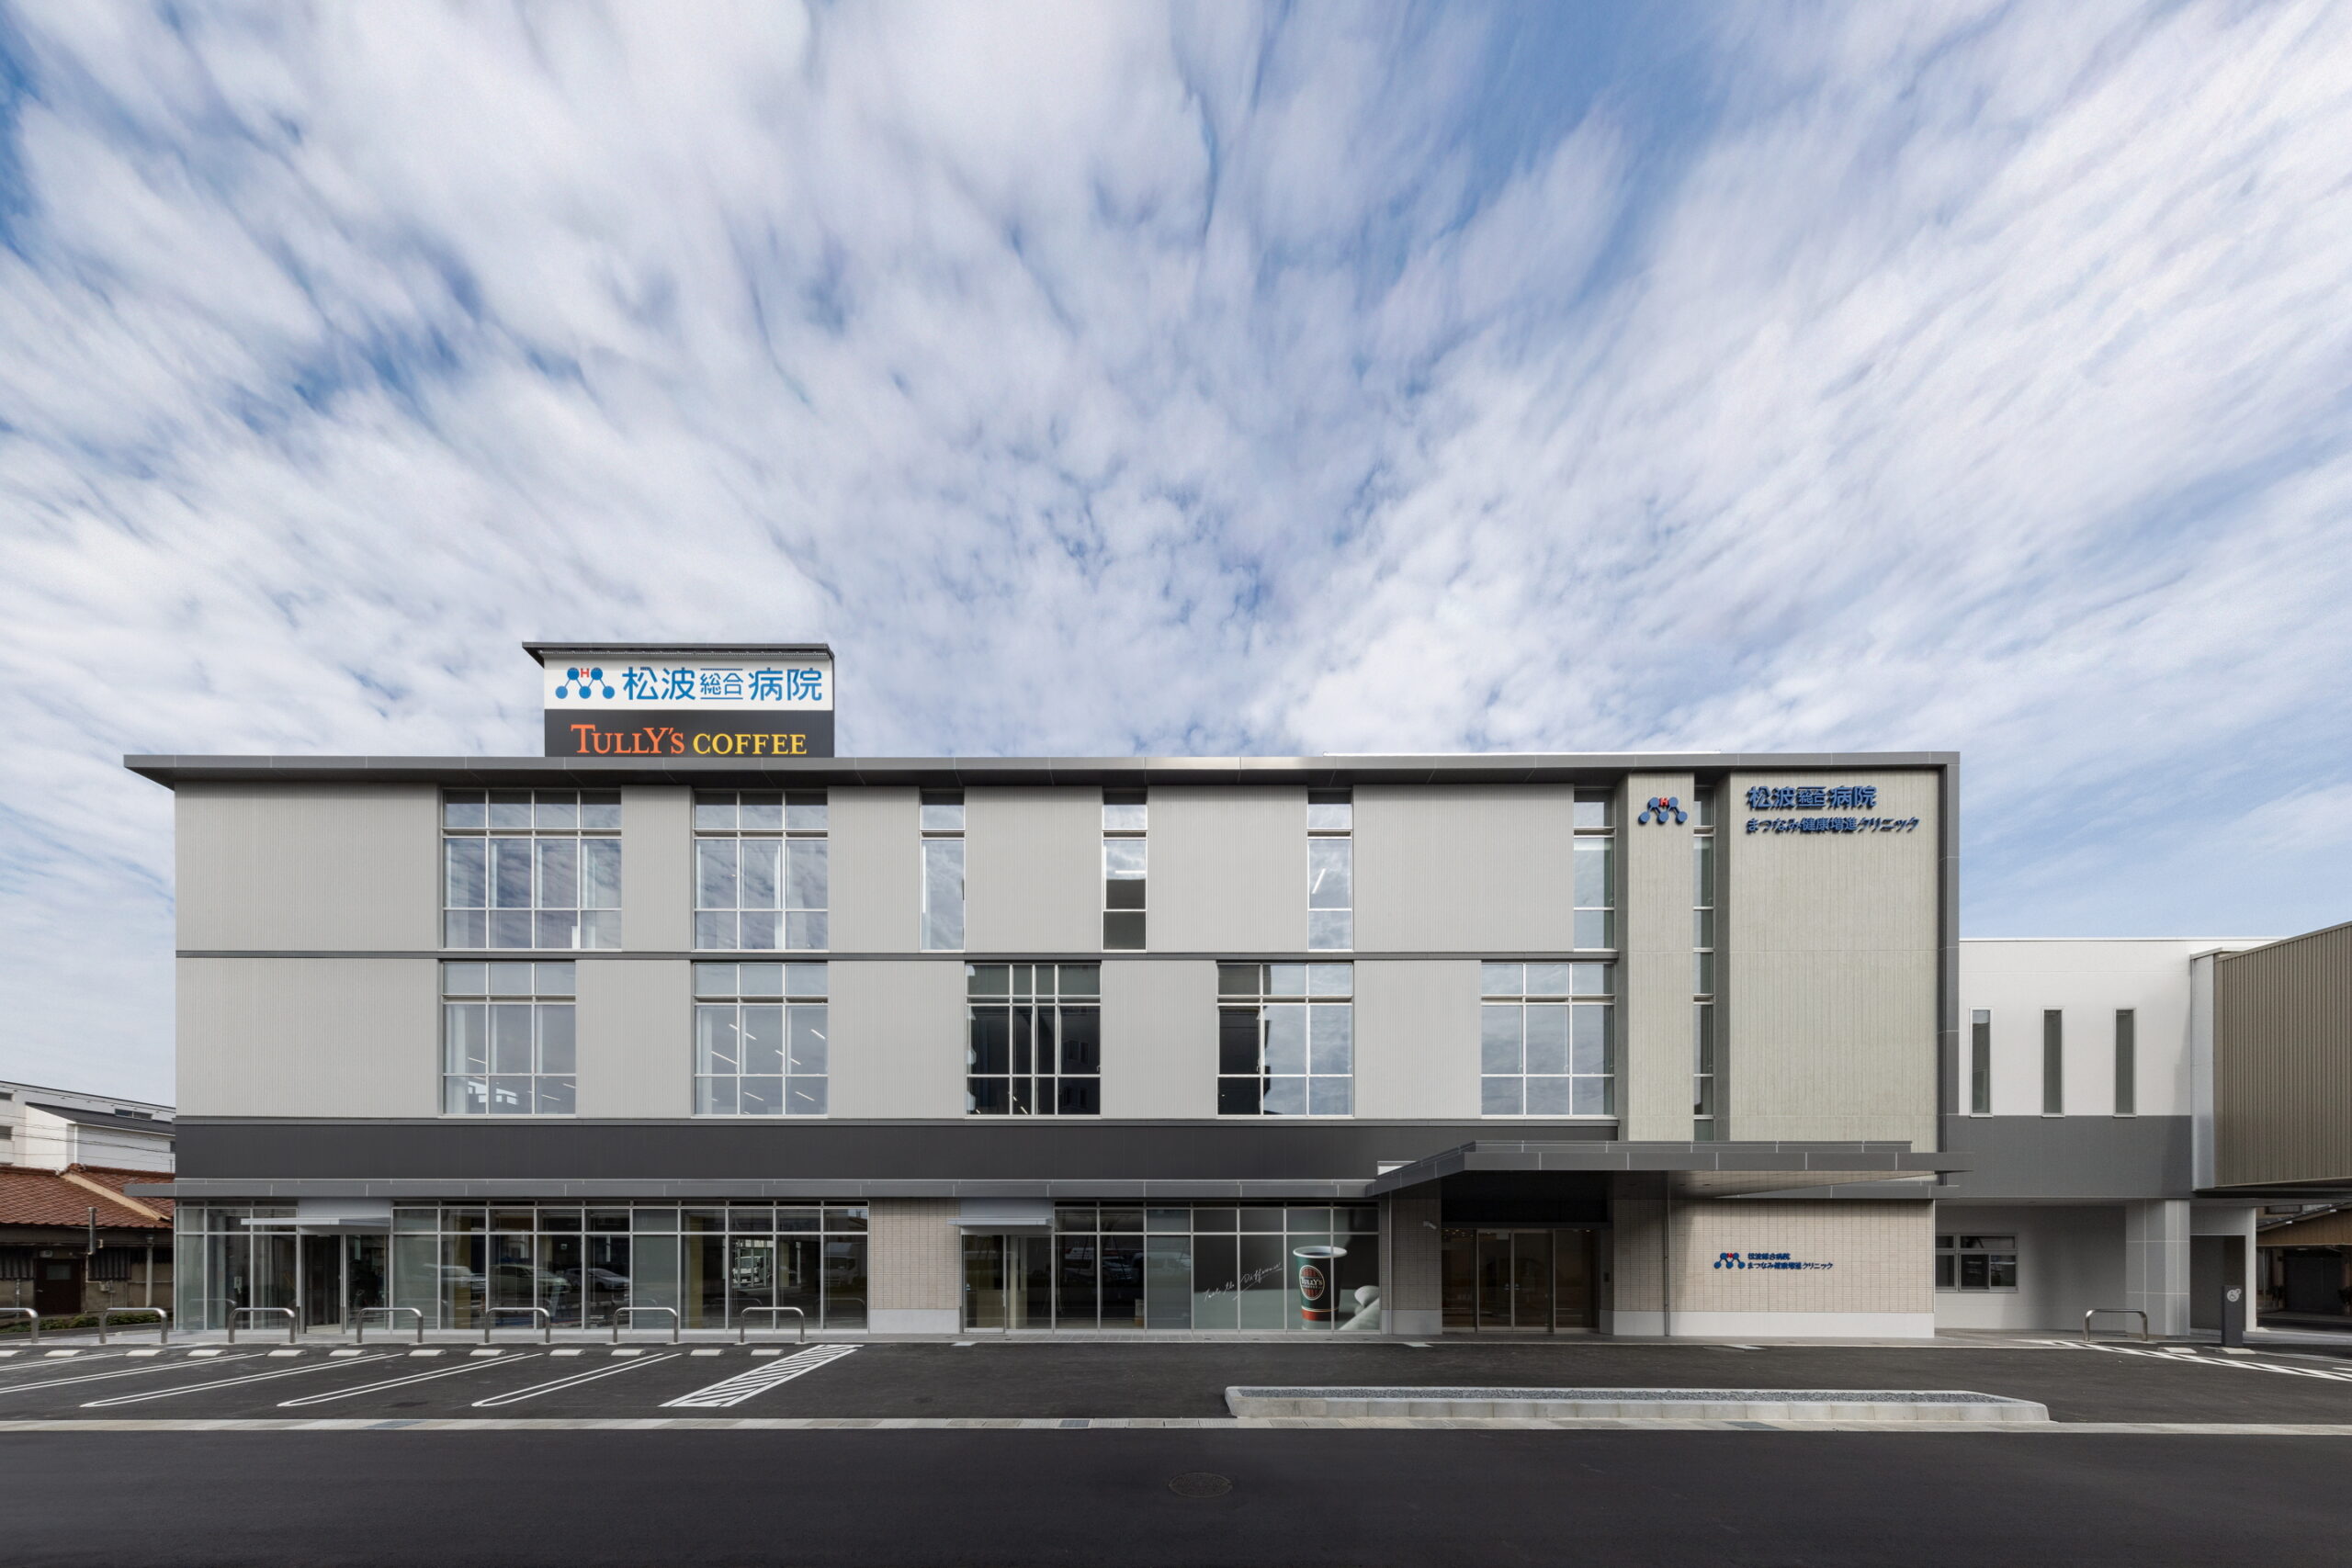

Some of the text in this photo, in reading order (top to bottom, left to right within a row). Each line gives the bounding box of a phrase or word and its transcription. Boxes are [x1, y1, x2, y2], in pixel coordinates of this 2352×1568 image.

[580, 667, 590, 678] H
[622, 667, 822, 701] 松波総合病院
[693, 733, 808, 754] COFFEE
[1747, 785, 1878, 808] 松波総合病院
[1747, 817, 1920, 833] まつなみ健康増進クリニック
